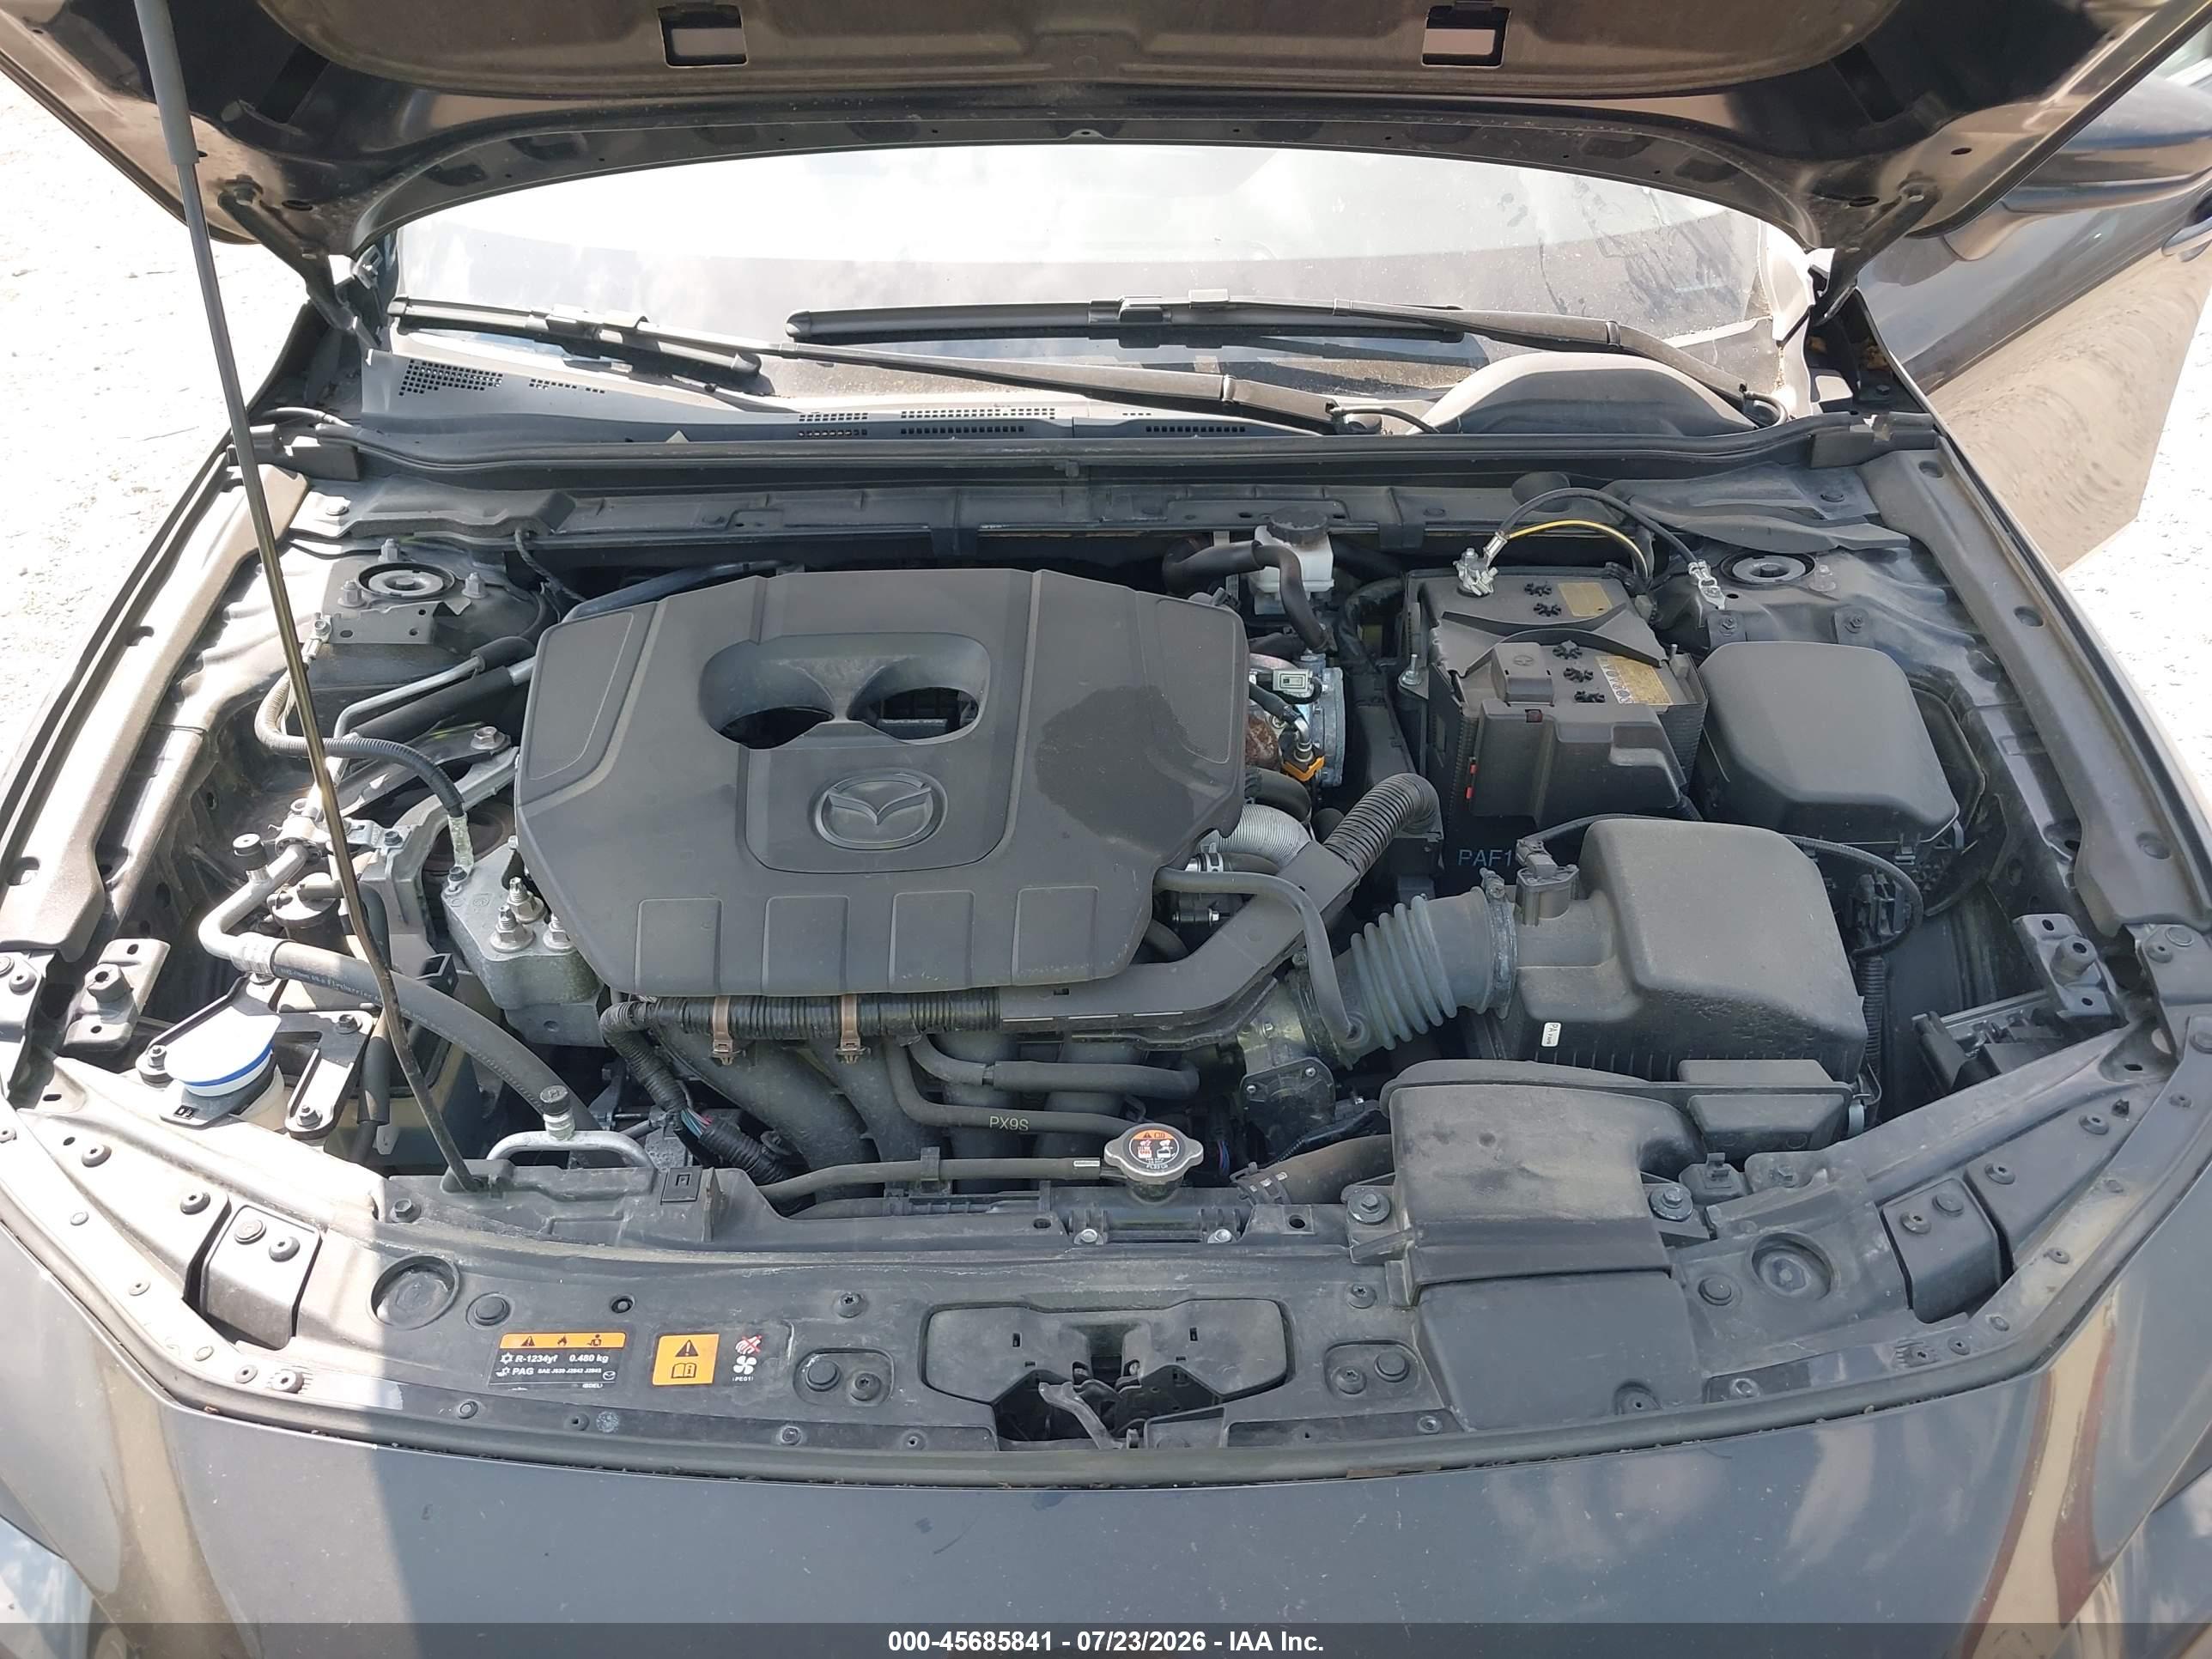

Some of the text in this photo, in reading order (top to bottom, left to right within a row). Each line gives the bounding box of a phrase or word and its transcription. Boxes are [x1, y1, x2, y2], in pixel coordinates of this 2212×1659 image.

[1457, 848, 1513, 866] PAF1
[988, 1115, 1030, 1132] PX9S
[514, 1354, 558, 1364] R-1234yf
[596, 1353, 609, 1364] kg
[512, 1367, 534, 1376] PAG
